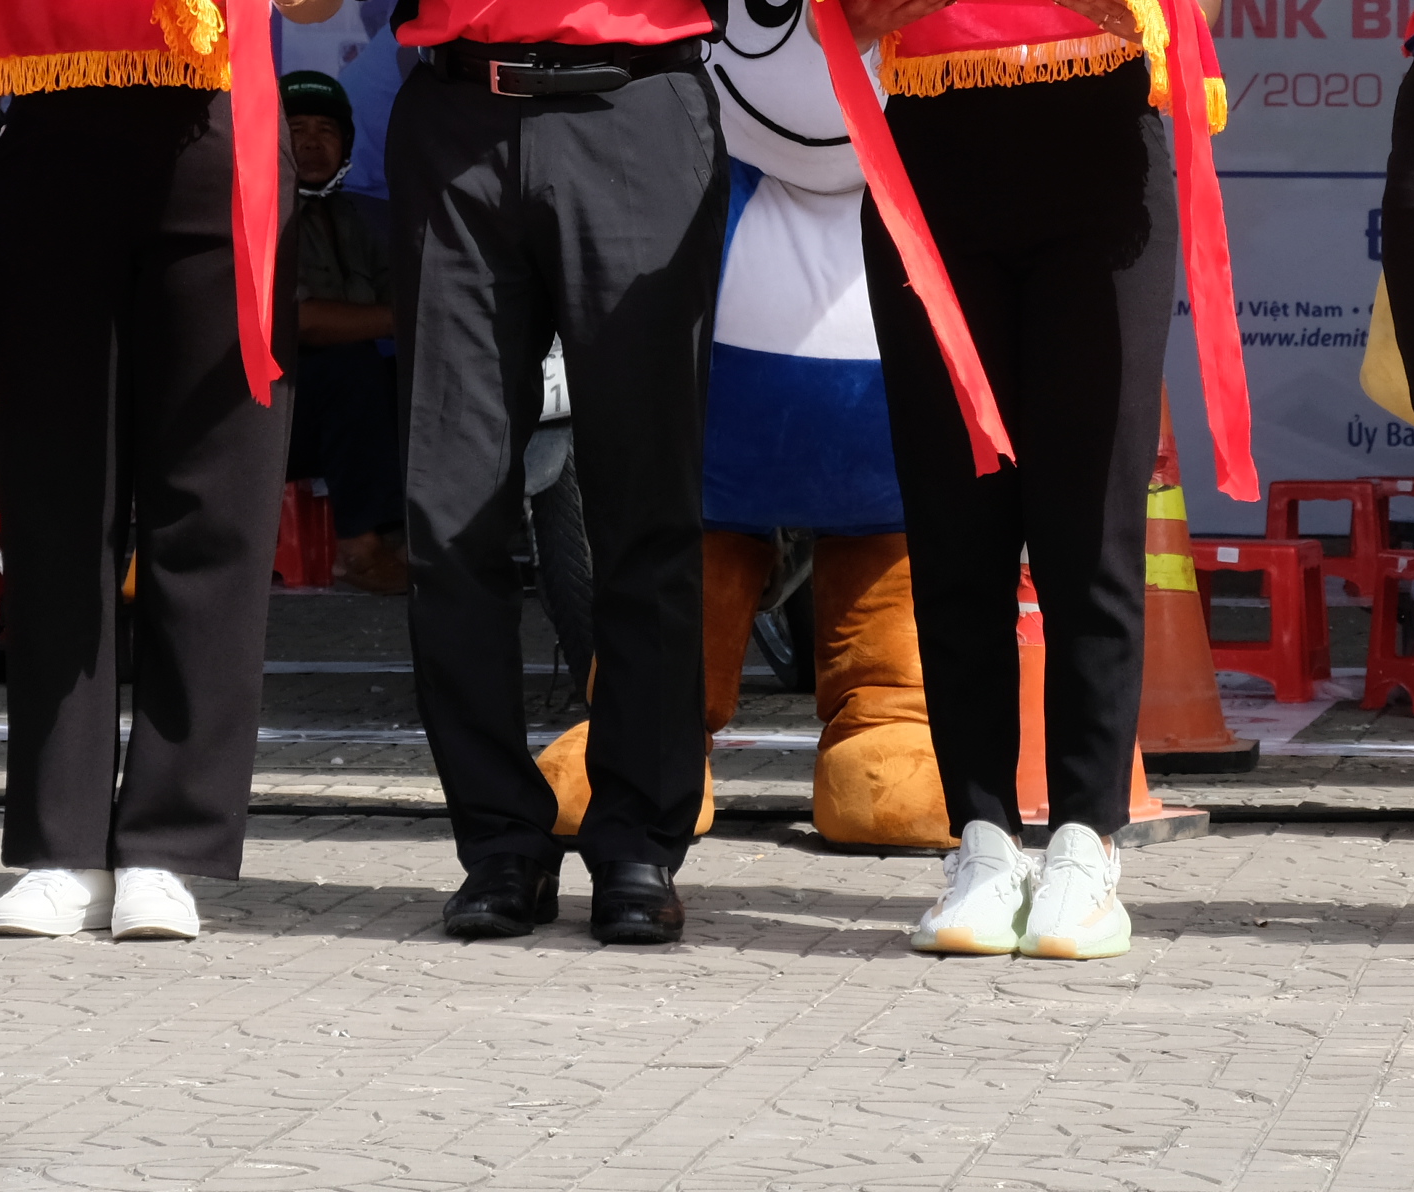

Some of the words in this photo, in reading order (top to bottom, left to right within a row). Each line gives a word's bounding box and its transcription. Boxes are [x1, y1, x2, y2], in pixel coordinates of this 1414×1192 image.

[1248, 300, 1290, 322] Việt
[1295, 302, 1343, 318] Nam
[1348, 414, 1378, 454] Ủy
